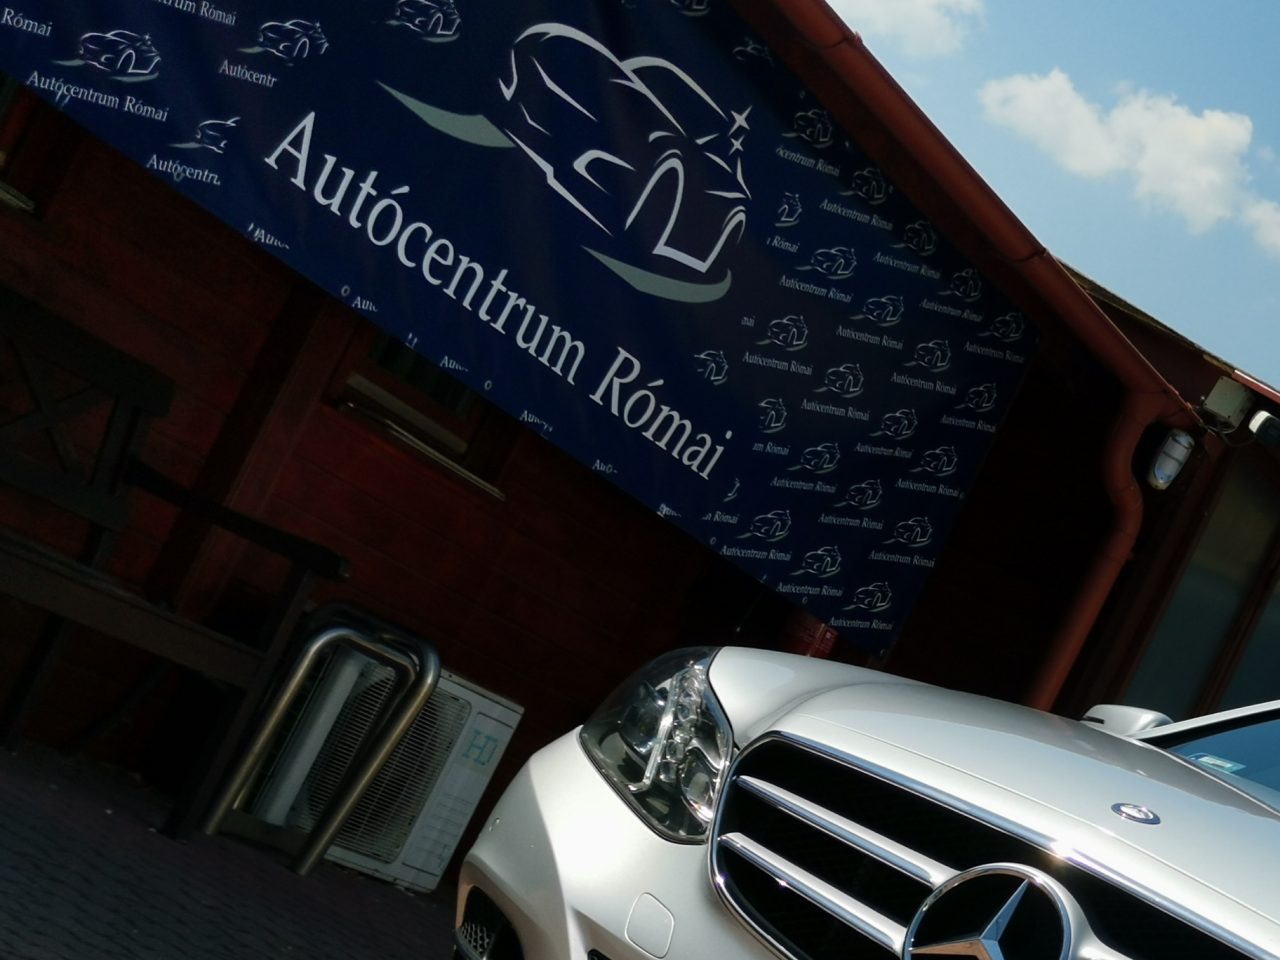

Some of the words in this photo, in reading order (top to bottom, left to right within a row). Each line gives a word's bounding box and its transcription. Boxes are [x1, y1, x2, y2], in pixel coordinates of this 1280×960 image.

[1, 7, 53, 37] Római
[200, 1, 237, 26] Római
[26, 70, 119, 109] Autócentrum
[124, 95, 169, 122] Római
[264, 111, 585, 385] Autócentrum
[589, 346, 733, 480] Római
